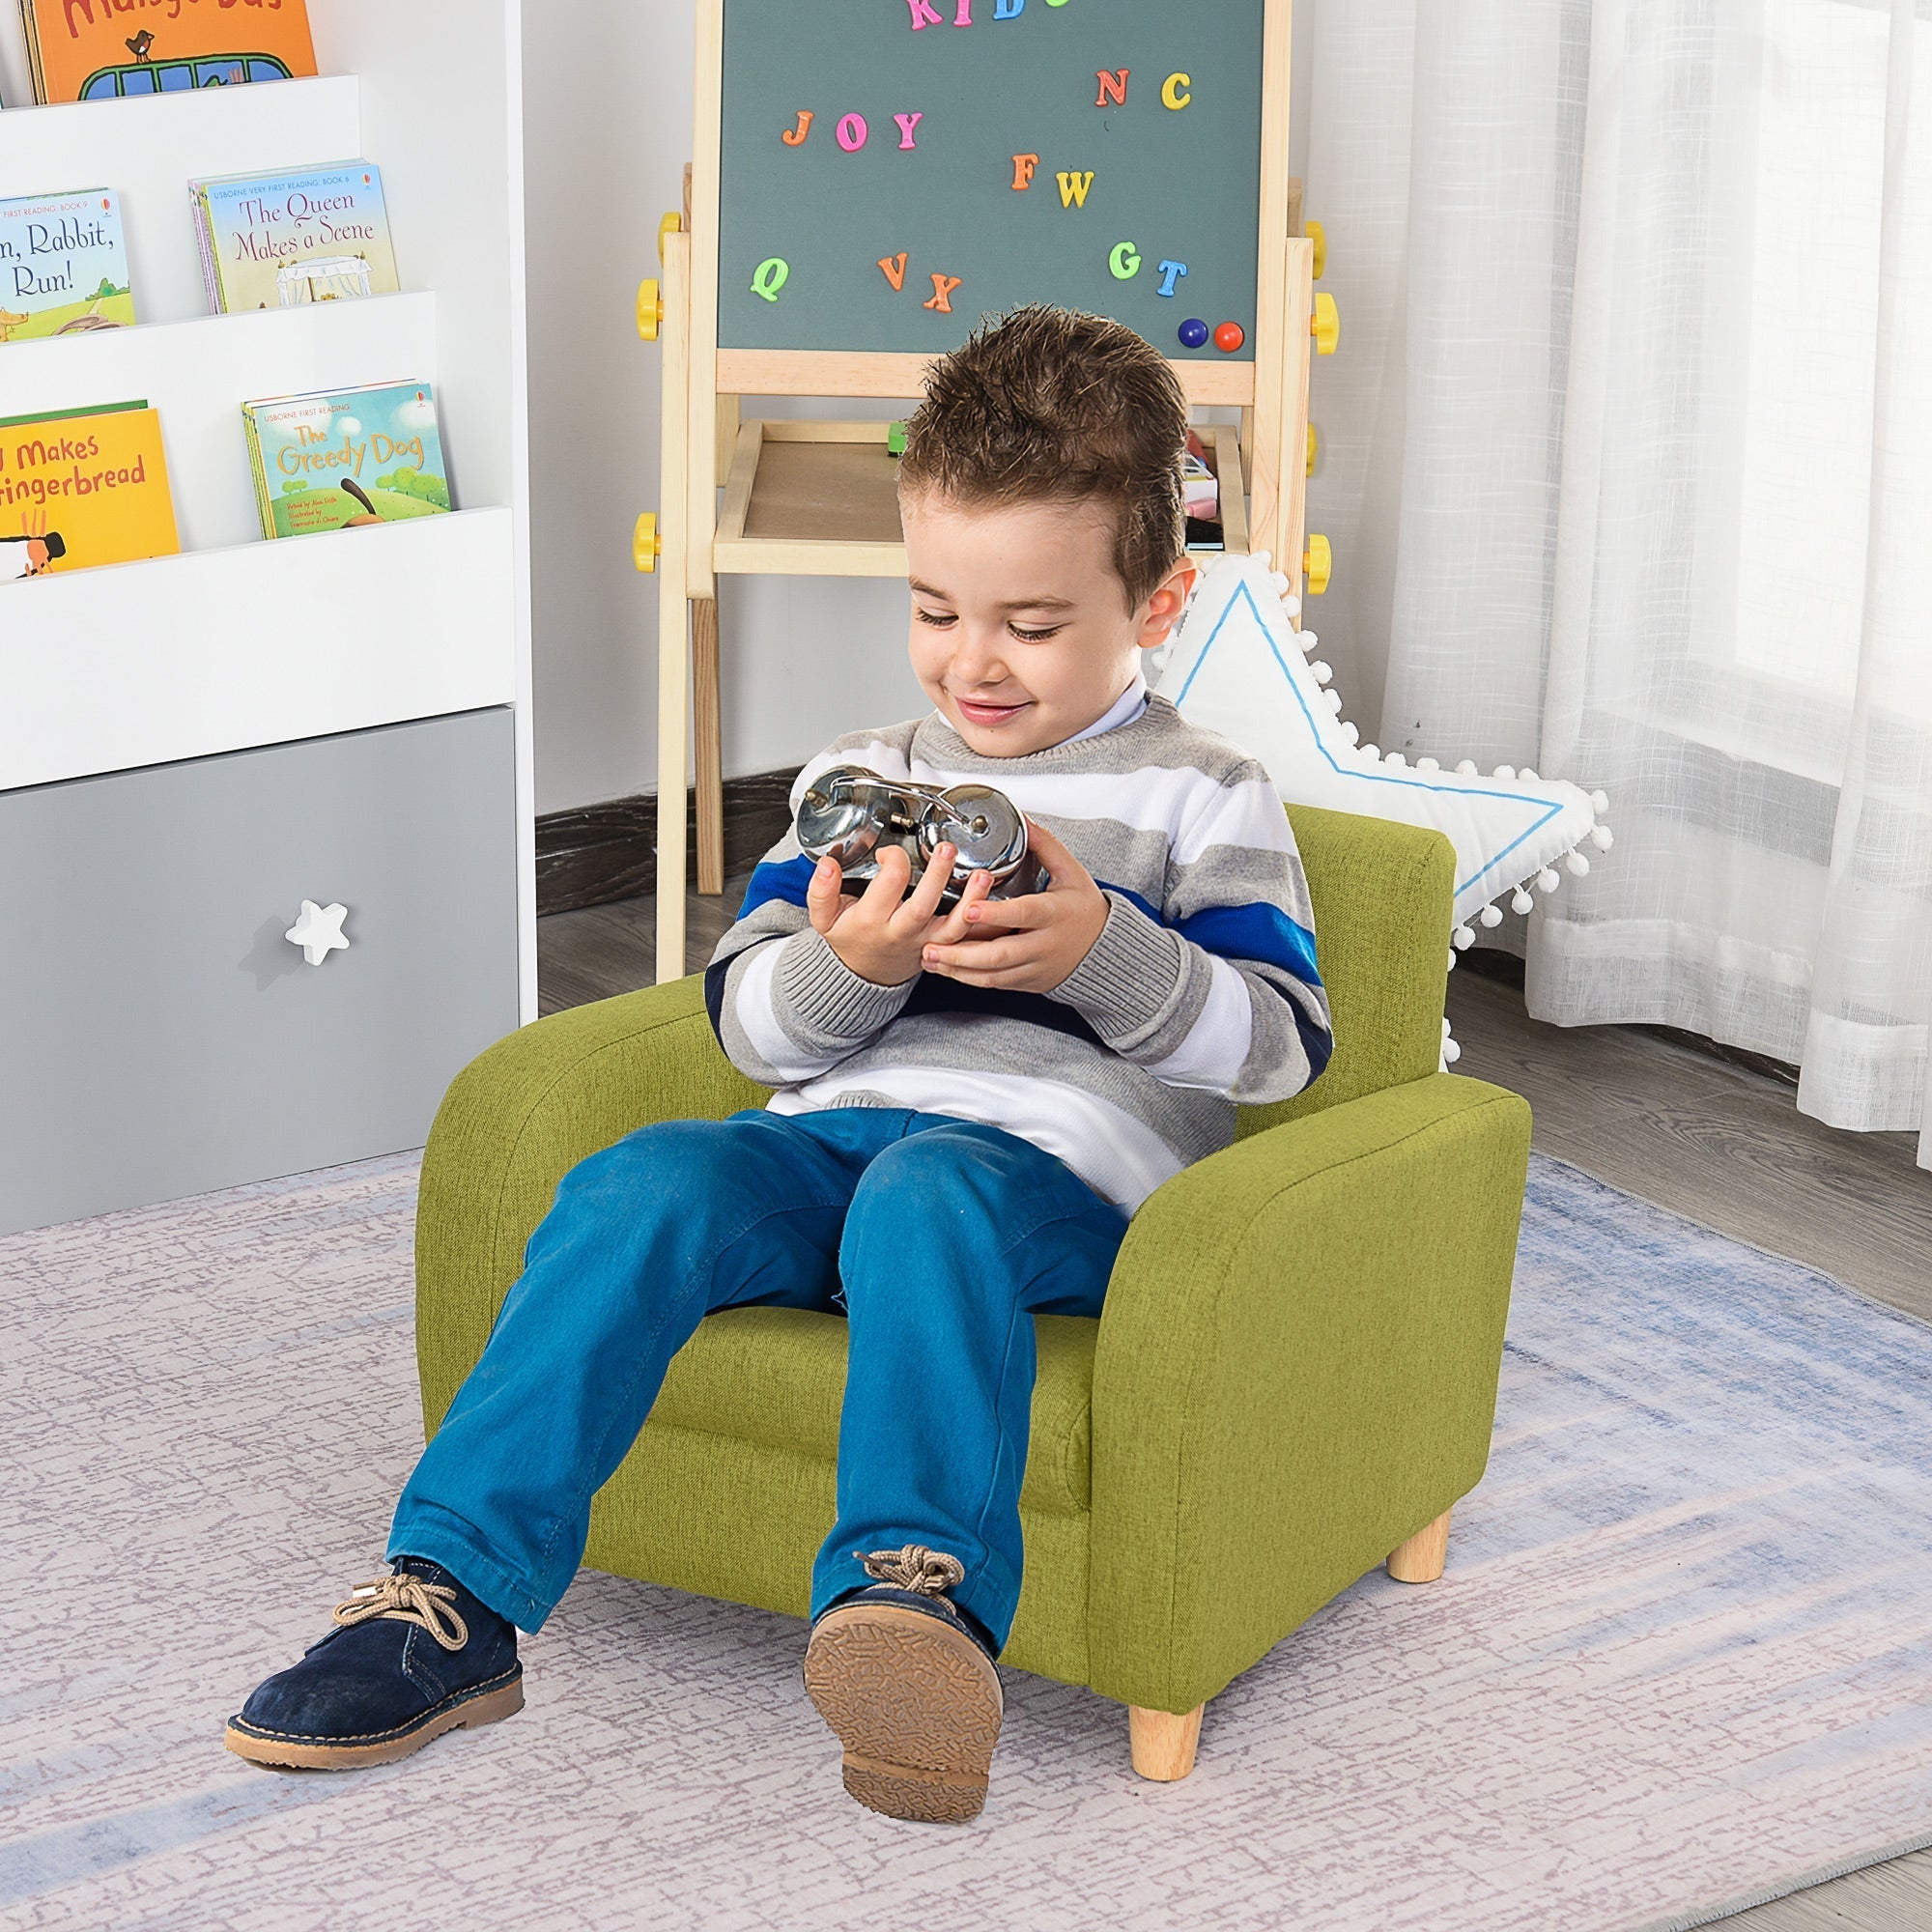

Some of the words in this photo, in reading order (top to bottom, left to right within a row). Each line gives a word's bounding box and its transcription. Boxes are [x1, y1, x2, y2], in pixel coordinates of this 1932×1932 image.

[906, 0, 1069, 30] KID
[1094, 68, 1130, 107] N
[1161, 71, 1191, 110] C
[781, 110, 923, 153] JOY
[268, 183, 286, 192] FIRST
[322, 176, 344, 185] BOOK
[1011, 153, 1039, 190] F
[1056, 171, 1094, 208] W
[3, 209, 21, 217] FIRST
[60, 202, 81, 211] BOOK
[239, 198, 280, 227] The
[287, 193, 356, 228] Queen
[26, 217, 114, 254] Rabbit,
[232, 231, 298, 261] Makes
[303, 234, 314, 249] a
[320, 215, 375, 244] Scene
[12, 260, 73, 297] Run!
[750, 257, 790, 302] Q
[877, 252, 908, 292] V
[923, 273, 963, 313] X
[1109, 242, 1142, 280] G
[1157, 259, 1187, 297] T
[264, 411, 297, 422] USBORNE
[299, 409, 316, 417] FIRST
[319, 403, 350, 413] READING
[16, 435, 99, 469] Makes
[294, 425, 327, 446] The
[277, 436, 366, 478] Greedy
[371, 434, 424, 470] Dog
